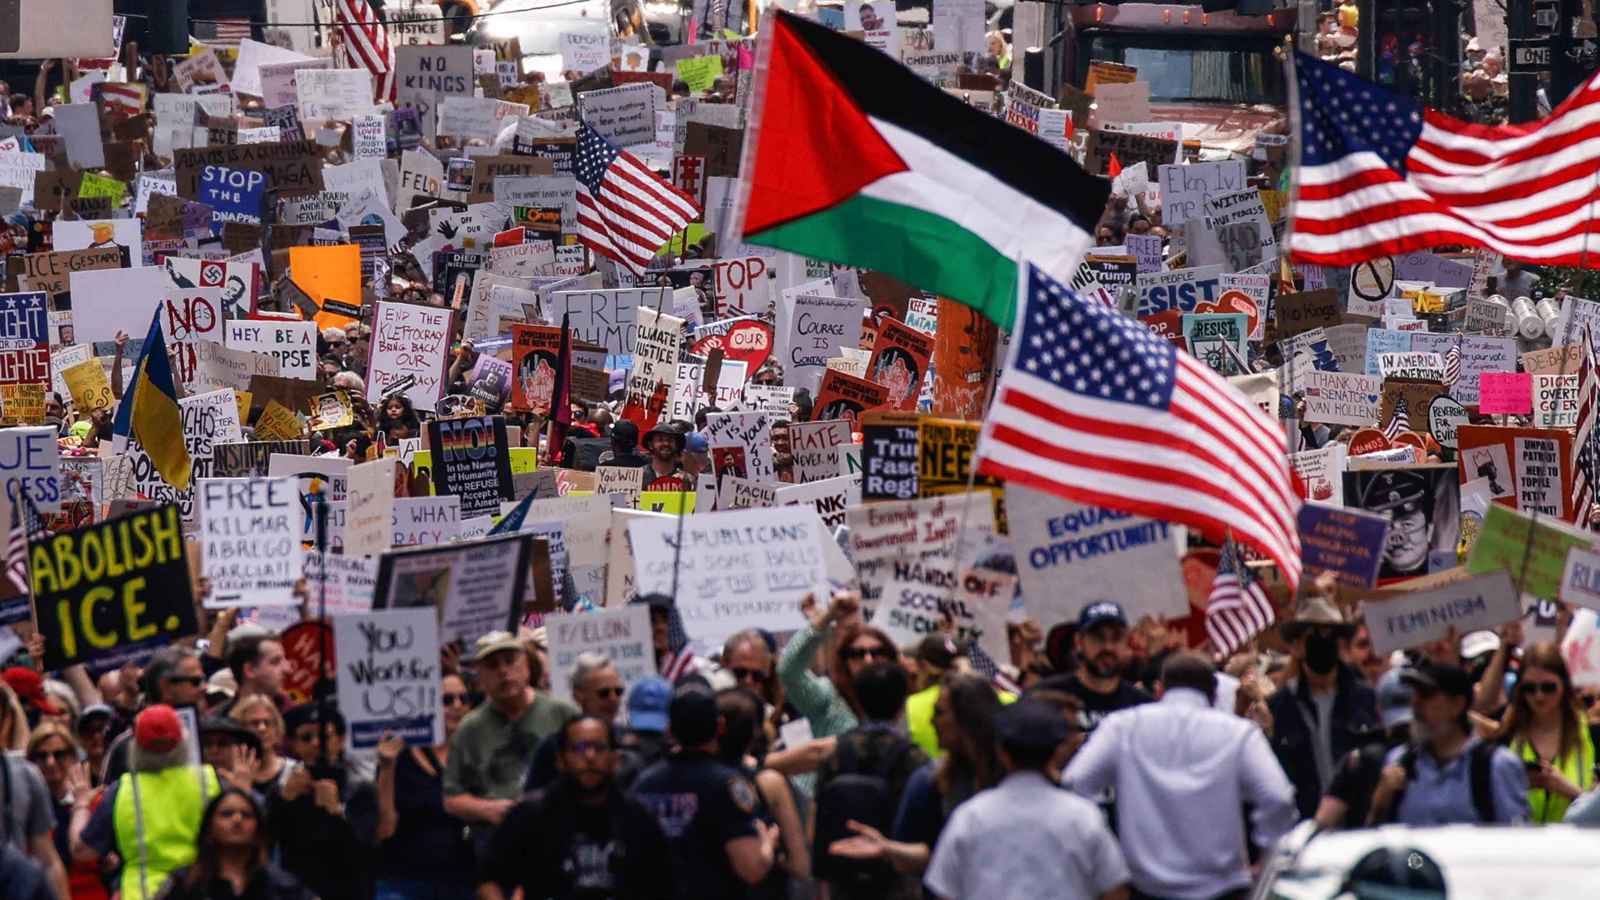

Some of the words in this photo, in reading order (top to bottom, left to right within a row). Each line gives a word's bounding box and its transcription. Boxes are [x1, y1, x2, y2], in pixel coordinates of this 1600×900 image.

[420, 57, 447, 72] NO
[405, 76, 466, 92] KINGS
[202, 165, 263, 193] STOP
[1167, 167, 1208, 193] Elon
[209, 188, 241, 203] THE
[26, 253, 62, 276] ICE
[713, 257, 766, 293] TOP
[0, 308, 43, 339] GHT
[165, 296, 216, 337] NO
[419, 311, 443, 325] THE
[797, 312, 845, 336] COURAGE
[275, 329, 295, 344] BE
[301, 329, 311, 345] A
[637, 324, 677, 348] CLIMATE
[734, 331, 763, 347] OUR
[1196, 320, 1234, 337] RESIST
[412, 341, 439, 354] BACK
[396, 353, 431, 368] OUR
[1313, 374, 1352, 389] THANK
[1540, 388, 1580, 401] OVERT
[1307, 402, 1331, 416] VAN
[709, 414, 732, 436] HOW
[791, 424, 842, 451] HATE
[873, 438, 918, 457] Tru
[204, 479, 289, 511] FREE
[464, 479, 499, 492] REFUSE
[410, 506, 459, 524] WHAT
[661, 521, 810, 550] RPUBLICANS
[1028, 519, 1170, 571] OPPORTUNITY
[31, 505, 182, 596] ABOLISH
[893, 560, 958, 590] HANDS
[57, 575, 181, 659] ICE.
[357, 620, 415, 655] You
